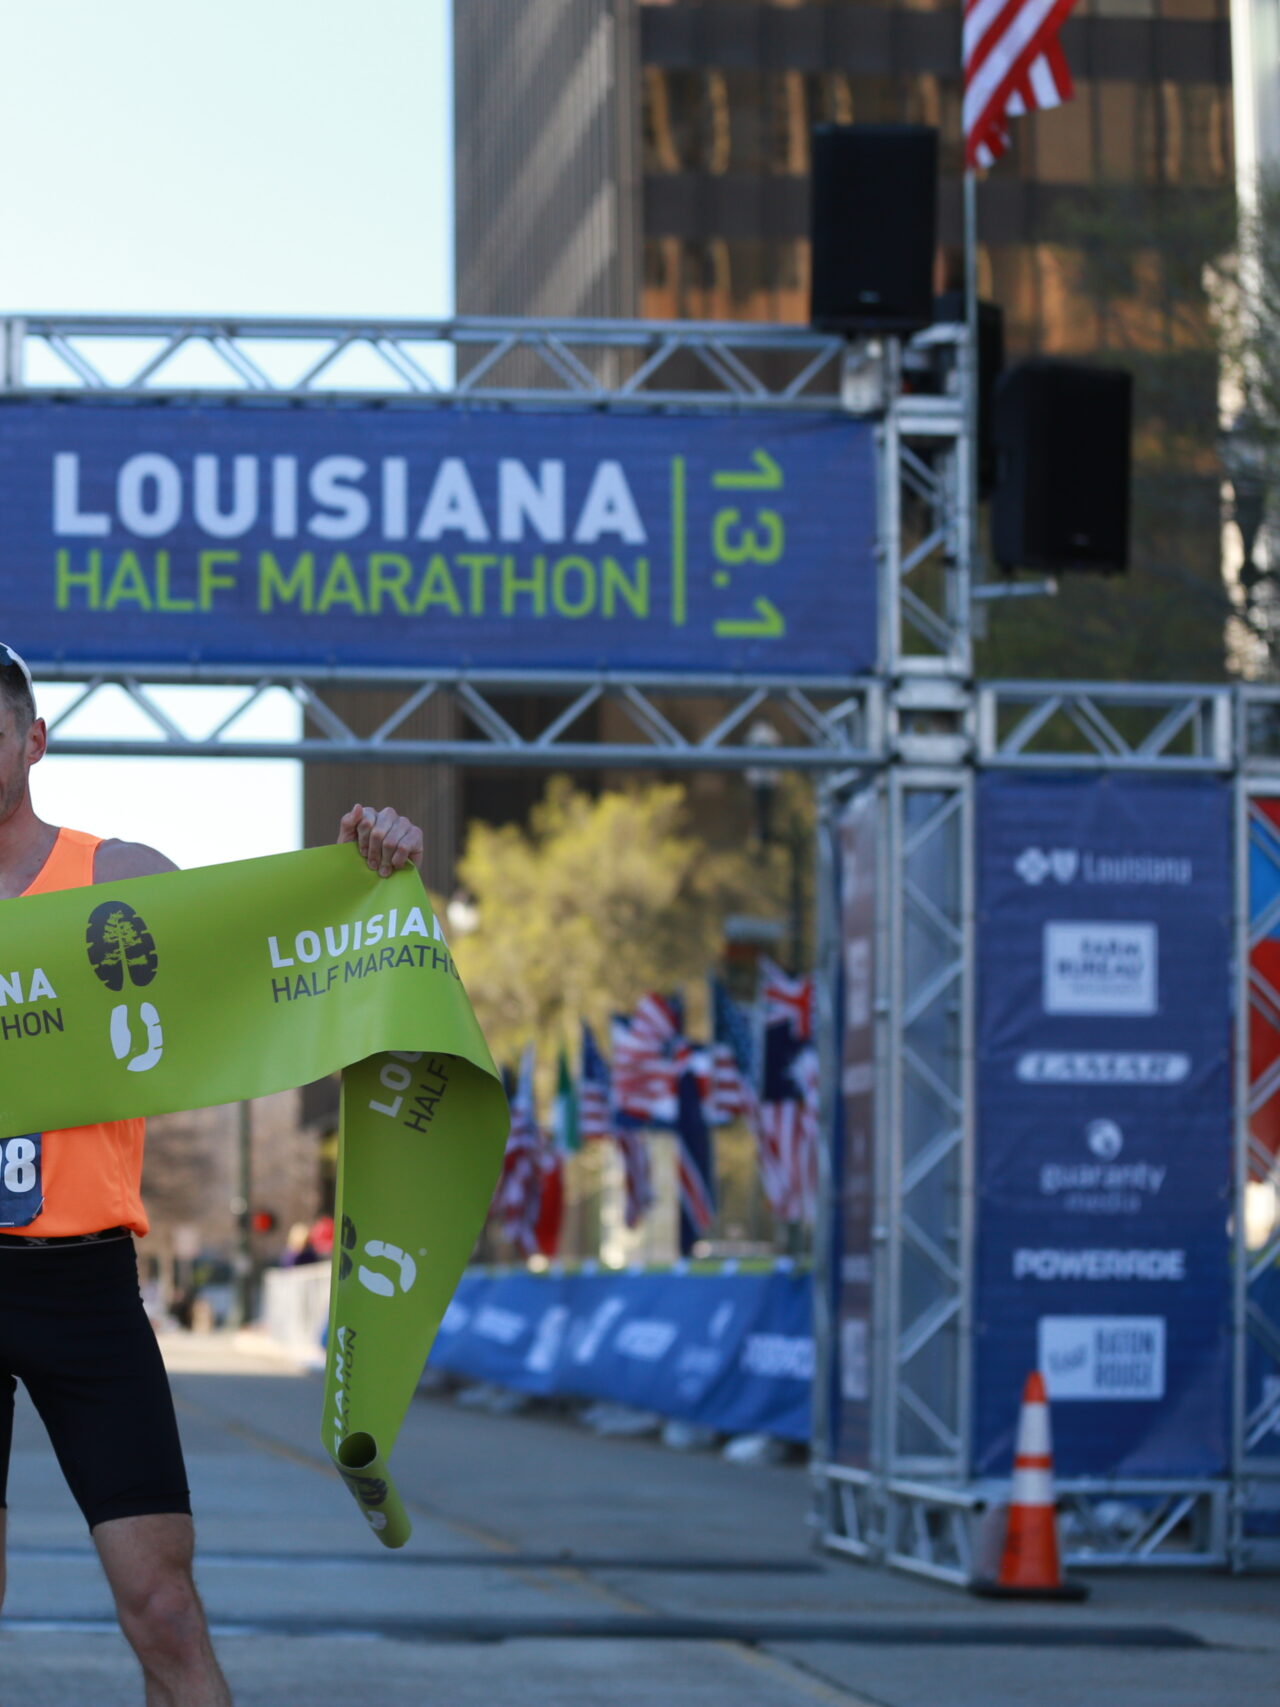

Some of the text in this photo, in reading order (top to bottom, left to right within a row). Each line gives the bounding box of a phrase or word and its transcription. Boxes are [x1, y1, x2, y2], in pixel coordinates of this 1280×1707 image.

[53, 453, 647, 543] LOUISIANA
[713, 450, 784, 637] 13.1
[55, 549, 648, 618] HALF MARATHON
[1084, 854, 1191, 885] Louisiana
[271, 965, 339, 1003] HALF
[403, 1058, 449, 1133] HALF
